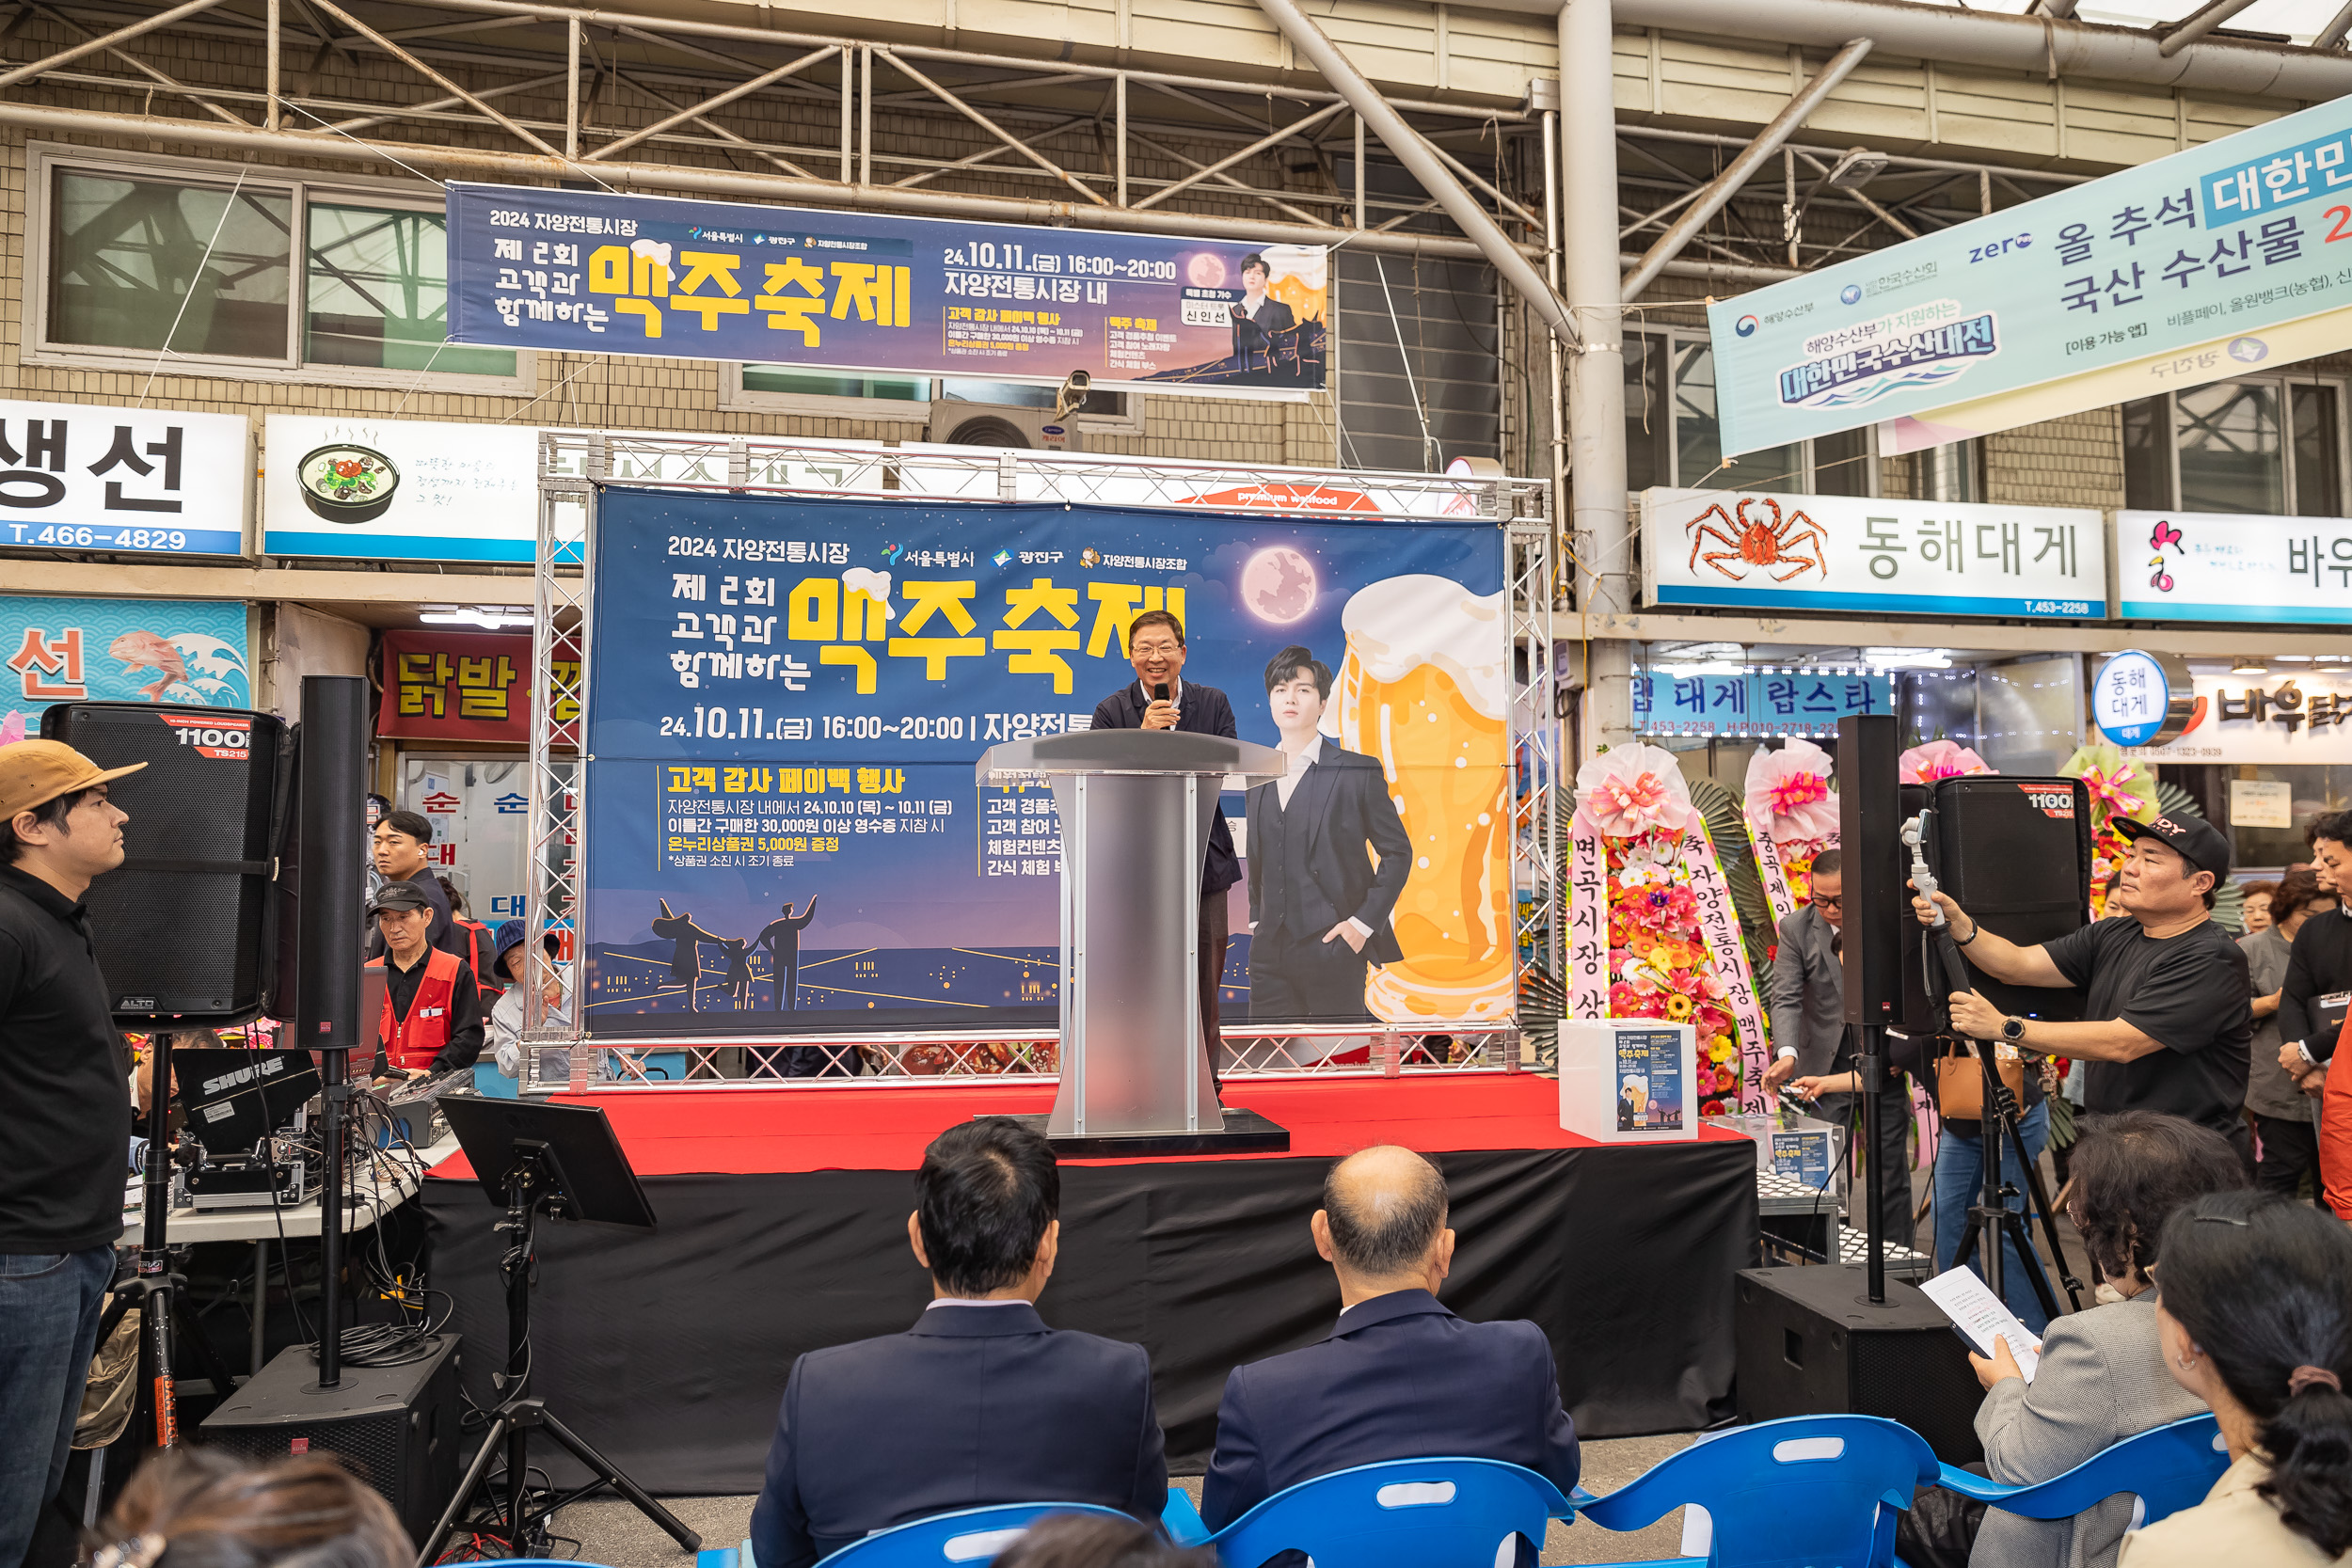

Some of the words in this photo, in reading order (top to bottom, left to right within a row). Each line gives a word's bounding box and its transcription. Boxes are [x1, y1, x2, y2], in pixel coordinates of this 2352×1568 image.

[489, 209, 531, 229] 2024
[533, 212, 639, 237] 자양전통시장
[2055, 222, 2094, 266] 올
[2109, 187, 2197, 246] 추석
[494, 238, 523, 261] 제
[532, 241, 580, 267] 2회
[769, 235, 796, 246] 광진구
[1068, 254, 1176, 281] 16:00~20:00
[2061, 261, 2146, 314] 국산
[2161, 215, 2305, 289] 수산물
[495, 267, 581, 299] 고객과
[944, 272, 1081, 304] 자양전통시장
[1086, 279, 1108, 306] 내
[494, 296, 610, 333] 함께하는
[948, 307, 972, 321] 고객
[974, 309, 998, 323] 감사
[1806, 319, 1893, 355] 해양수산부가
[1896, 302, 1957, 330] 지원하는
[2099, 328, 2125, 347] 가능
[1781, 315, 1996, 403] 대한민국수산대전
[0, 419, 183, 514] 생선
[8, 523, 186, 550] T.466-4829
[668, 535, 717, 557] 2024
[723, 538, 850, 564] 자양전통시장
[1859, 516, 2077, 579] 동해대게
[904, 550, 975, 569] 서울특별시
[1018, 550, 1064, 565] 광진구
[1102, 554, 1187, 572] 자양전통시장조합
[672, 572, 707, 602] 제
[720, 576, 775, 607] 2회
[2025, 600, 2090, 615] T.453-2258
[671, 611, 777, 652] 고객과
[8, 626, 88, 702] 선
[669, 649, 812, 692] 함께하는
[398, 652, 517, 721] 닭발
[2111, 667, 2147, 697] 동해
[1674, 677, 1747, 715] 대게
[1767, 677, 1876, 716] 랍스타
[2111, 694, 2149, 718] 대게
[175, 727, 246, 748] 1100
[822, 714, 962, 741] 16:00~20:00
[214, 749, 247, 758] TS215
[667, 767, 716, 793] 고객
[723, 767, 773, 793] 감사
[778, 767, 850, 794] 페이백
[856, 768, 906, 794] 행사
[667, 800, 755, 816] 자양전통시장
[757, 800, 801, 816] 내에서
[803, 800, 854, 815] 24.10.10
[857, 800, 882, 816] (목)
[898, 800, 926, 815] 10.11
[929, 800, 953, 816] (금)
[987, 799, 1017, 815] 고객
[2028, 793, 2071, 809] 1100
[667, 818, 712, 834] 이틀간
[714, 818, 758, 833] 구매한
[761, 818, 819, 834] 30,000원
[823, 818, 851, 834] 이상
[854, 818, 897, 834] 영수증
[899, 818, 928, 834] 지참
[930, 818, 945, 834] 시
[987, 818, 1017, 835] 고객
[1021, 818, 1050, 835] 참여
[667, 836, 755, 852] 온누리상품권
[757, 837, 808, 852] 5,000원
[811, 837, 839, 852] 증정
[987, 838, 1061, 856] 체험컨텐츠
[709, 855, 732, 867] 소진
[734, 855, 746, 867] 시
[747, 855, 770, 867] 조기
[771, 855, 795, 867] 종료
[987, 859, 1017, 876] 간식
[1021, 859, 1050, 876] 체험
